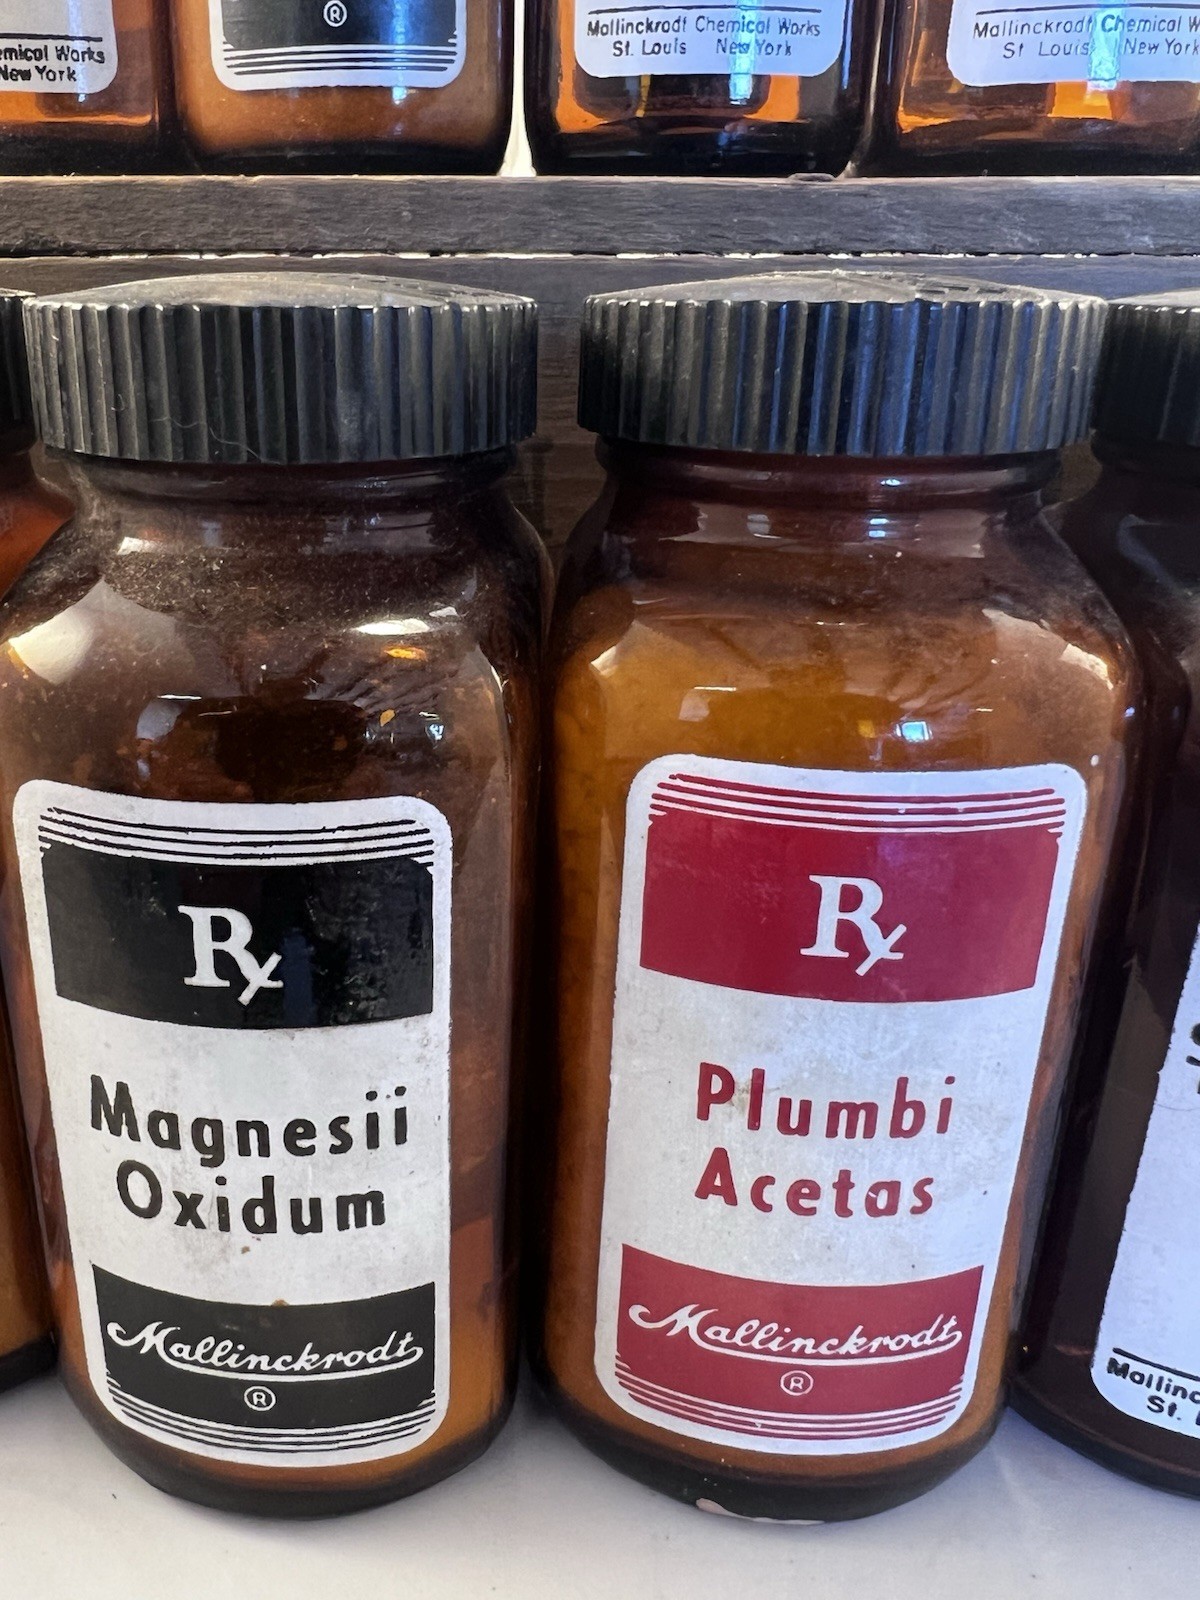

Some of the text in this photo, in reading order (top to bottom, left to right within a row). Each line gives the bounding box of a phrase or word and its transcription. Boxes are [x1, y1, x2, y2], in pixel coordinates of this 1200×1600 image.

[587, 15, 820, 36] Mallinckrodt Chemical Works
[973, 16, 1094, 39] Mallinckrodt
[1101, 14, 1182, 33] Chemical
[55, 45, 105, 64] Works
[641, 39, 688, 55] Louis
[716, 37, 751, 55] New
[755, 38, 793, 56] York
[1038, 41, 1091, 57] Louis
[1124, 38, 1160, 56] New
[1165, 37, 1200, 56] York
[35, 65, 77, 82] York
[696, 1061, 956, 1140] Plumbi
[90, 1074, 409, 1168] Magnesii
[695, 1146, 935, 1218] Acetas
[116, 1160, 386, 1235] Oxidum
[627, 1303, 963, 1367] Mallinckrodt
[106, 1320, 424, 1383] Mallinckrodt
[1146, 1395, 1182, 1421] St.
